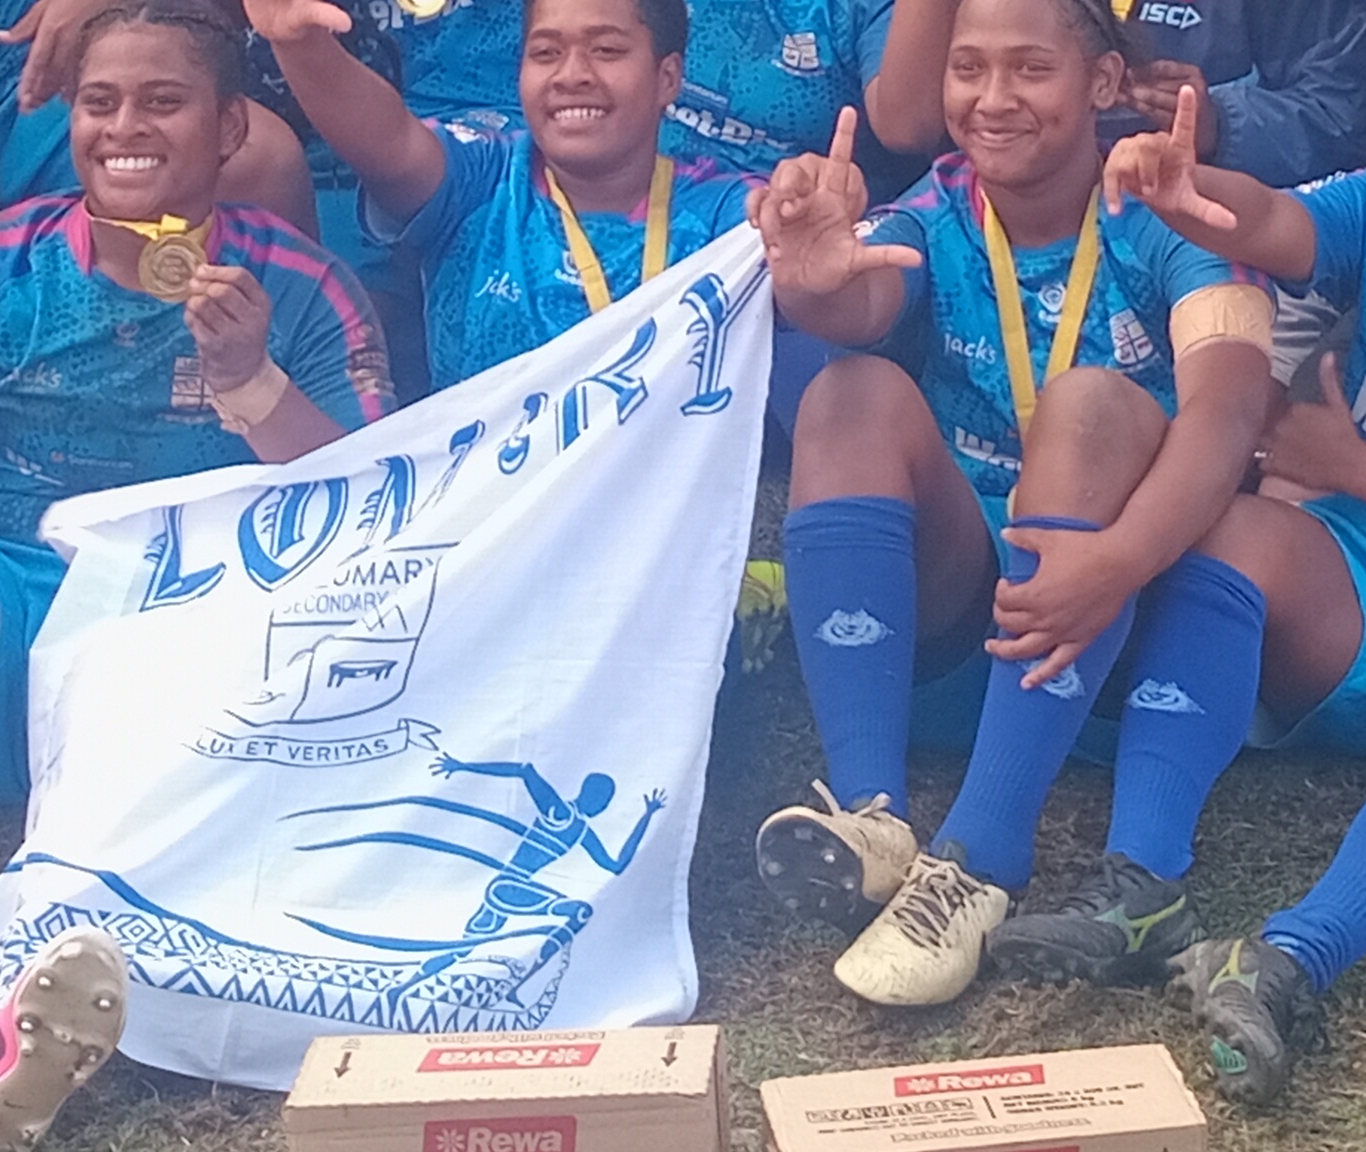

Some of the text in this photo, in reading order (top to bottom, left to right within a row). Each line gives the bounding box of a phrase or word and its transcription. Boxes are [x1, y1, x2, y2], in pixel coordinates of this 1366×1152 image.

[245, 740, 278, 756] ET
[287, 737, 389, 762] VERITAS
[436, 1048, 549, 1066] Rewa
[934, 1069, 1035, 1091] Rewa
[468, 1126, 564, 1152] Rewa
